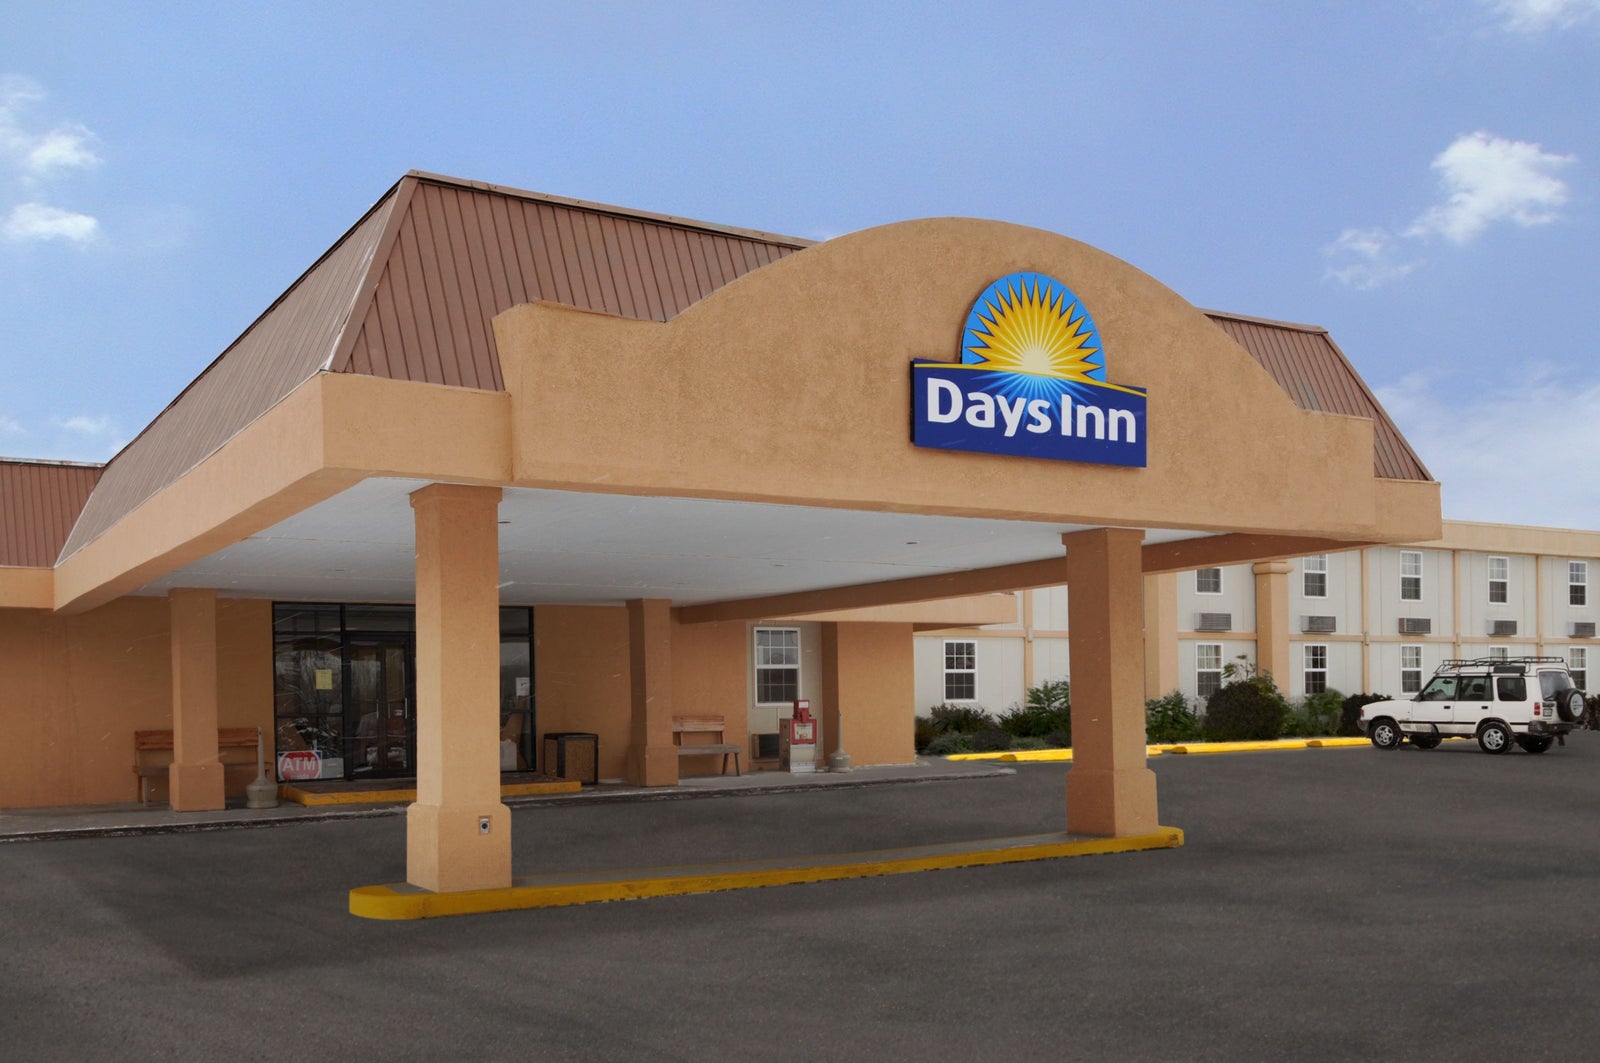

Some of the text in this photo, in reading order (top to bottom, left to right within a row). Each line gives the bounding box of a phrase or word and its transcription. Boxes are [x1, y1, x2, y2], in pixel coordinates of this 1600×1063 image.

[927, 378, 1136, 443] Days Inn
[283, 757, 315, 771] ATM
